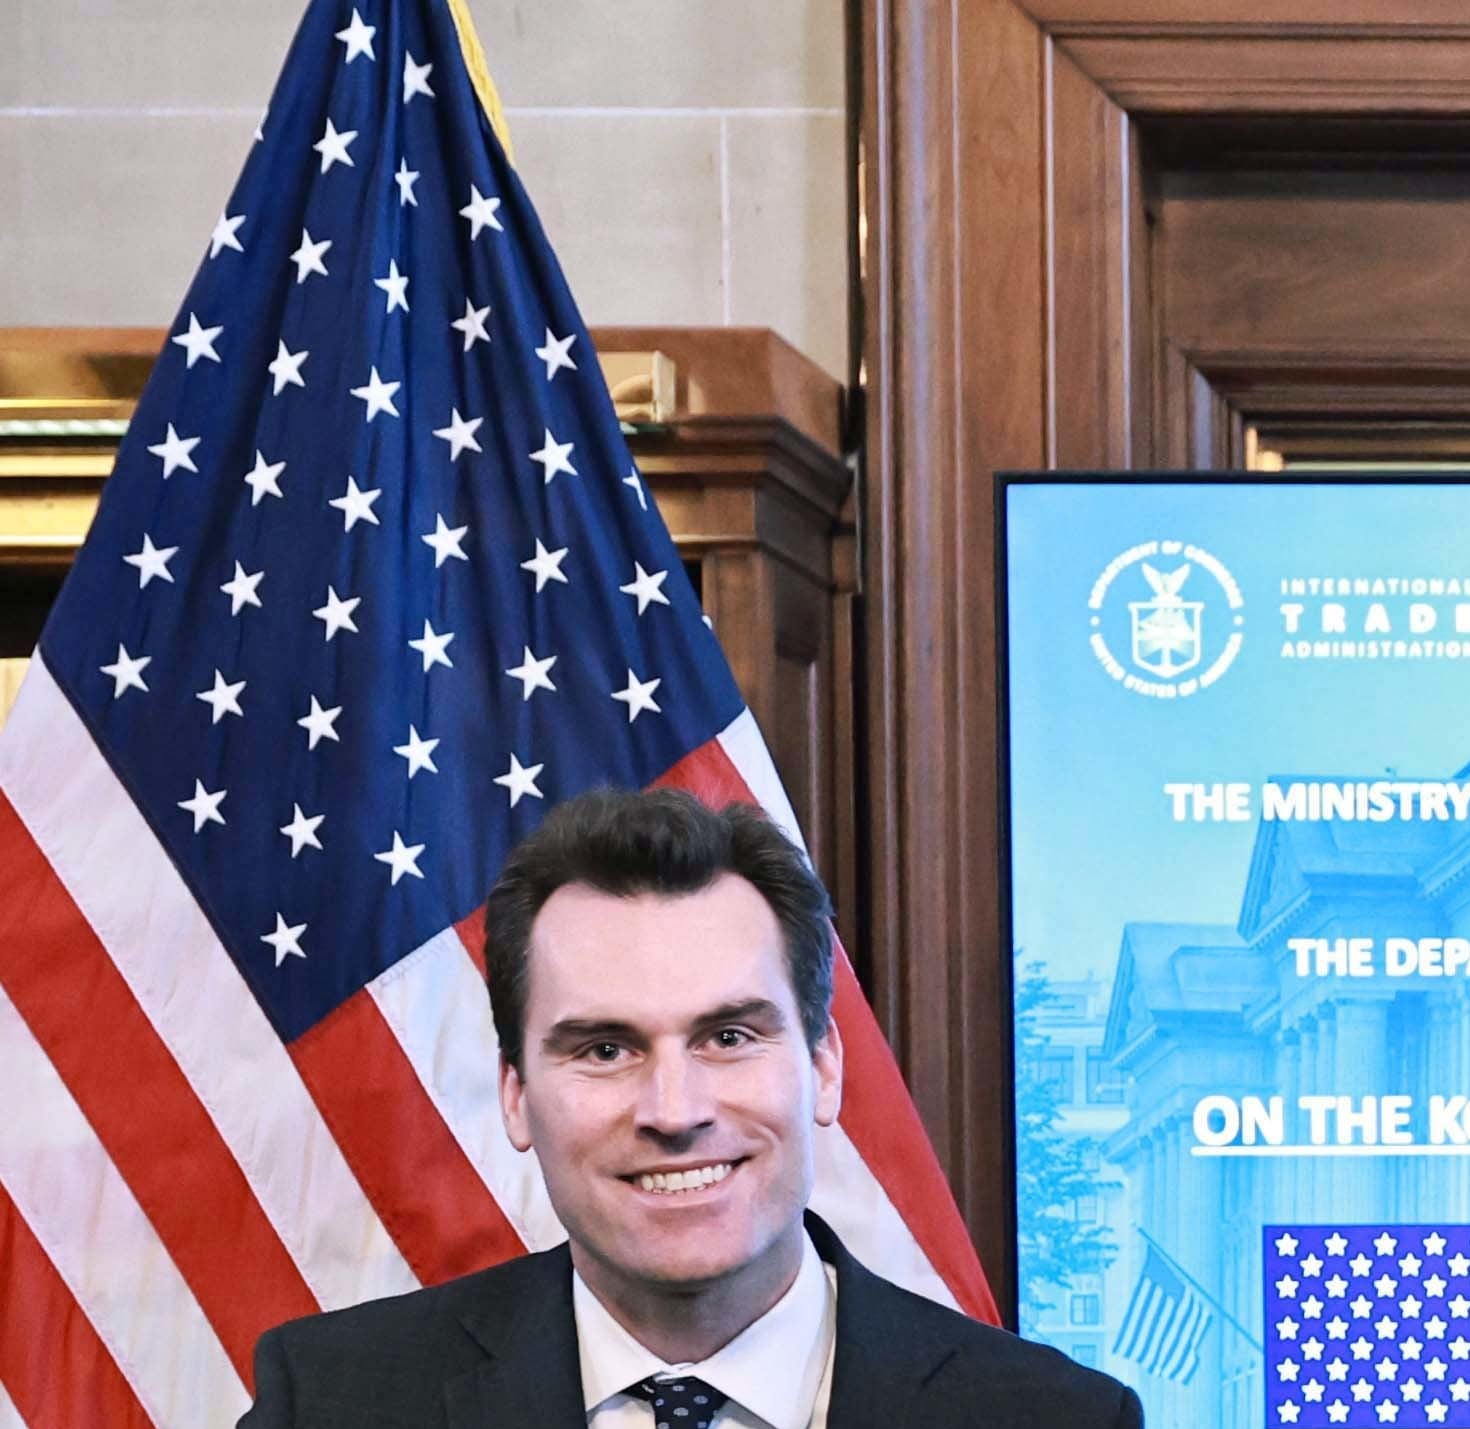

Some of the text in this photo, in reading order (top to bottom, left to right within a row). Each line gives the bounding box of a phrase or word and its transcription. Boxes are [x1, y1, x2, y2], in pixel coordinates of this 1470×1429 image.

[1164, 782, 1251, 822] THE
[1288, 937, 1374, 977] THE
[1193, 1094, 1284, 1147] ON
[1298, 1094, 1413, 1145] THE
